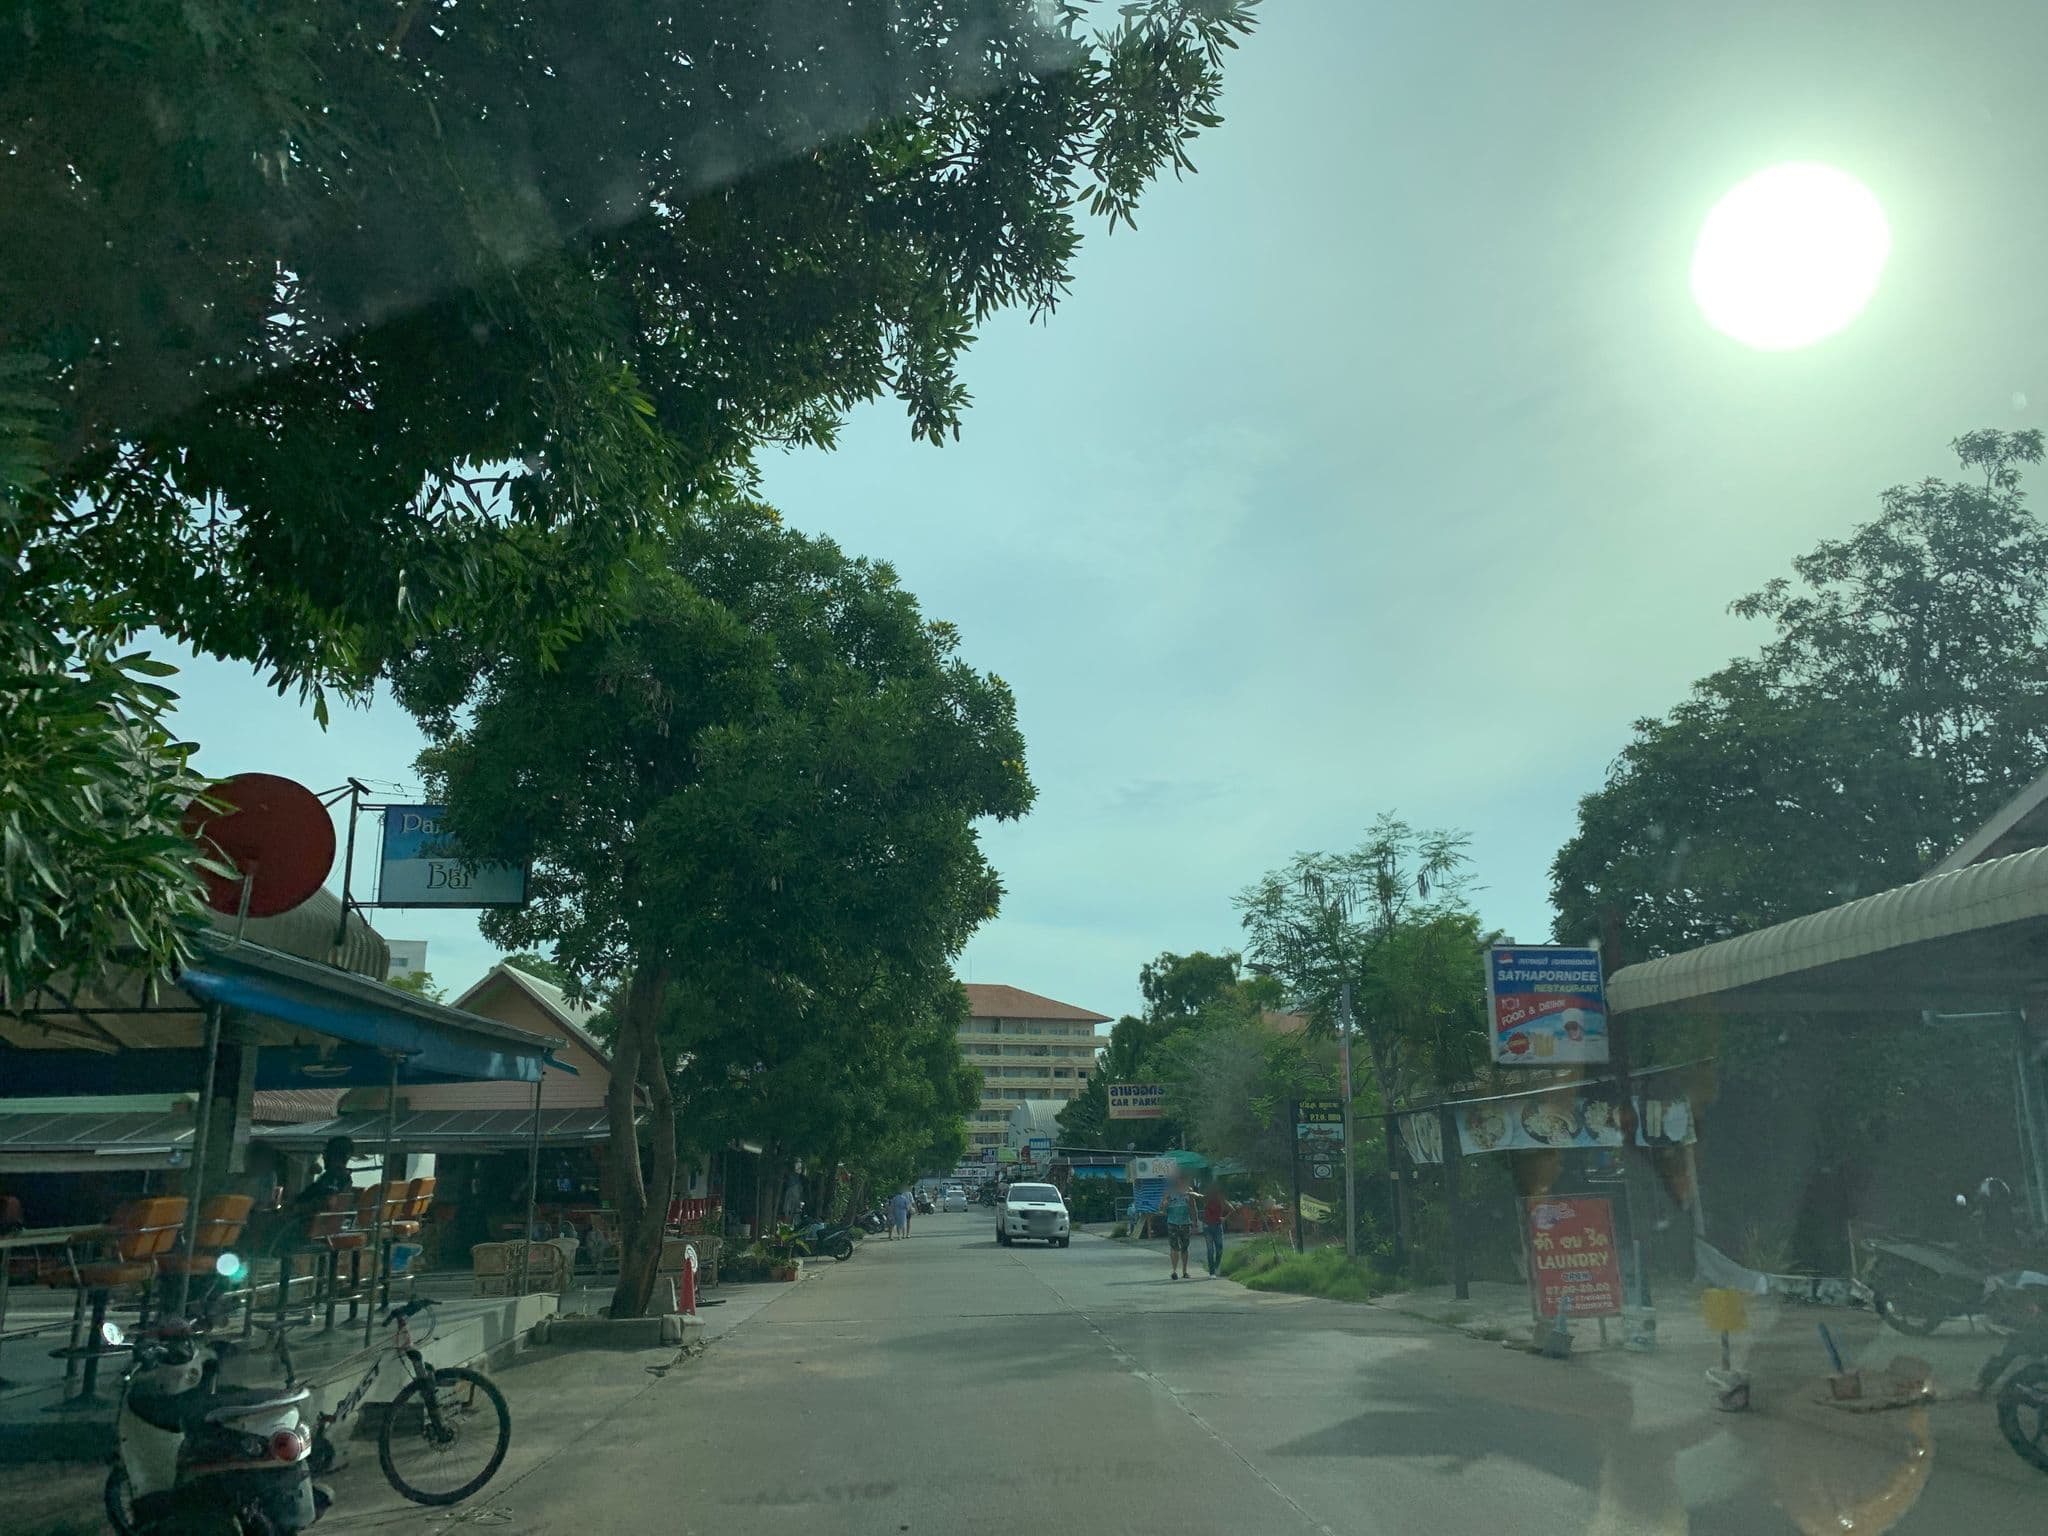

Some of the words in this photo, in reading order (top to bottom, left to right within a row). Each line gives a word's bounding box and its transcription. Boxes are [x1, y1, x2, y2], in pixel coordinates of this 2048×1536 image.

[426, 862, 472, 889] Bar
[1497, 970, 1598, 982] SATHAPORNDEE
[1501, 1009, 1526, 1026] FOOD
[1111, 1098, 1129, 1107] CAR
[1537, 1251, 1609, 1270] LAUNDRY
